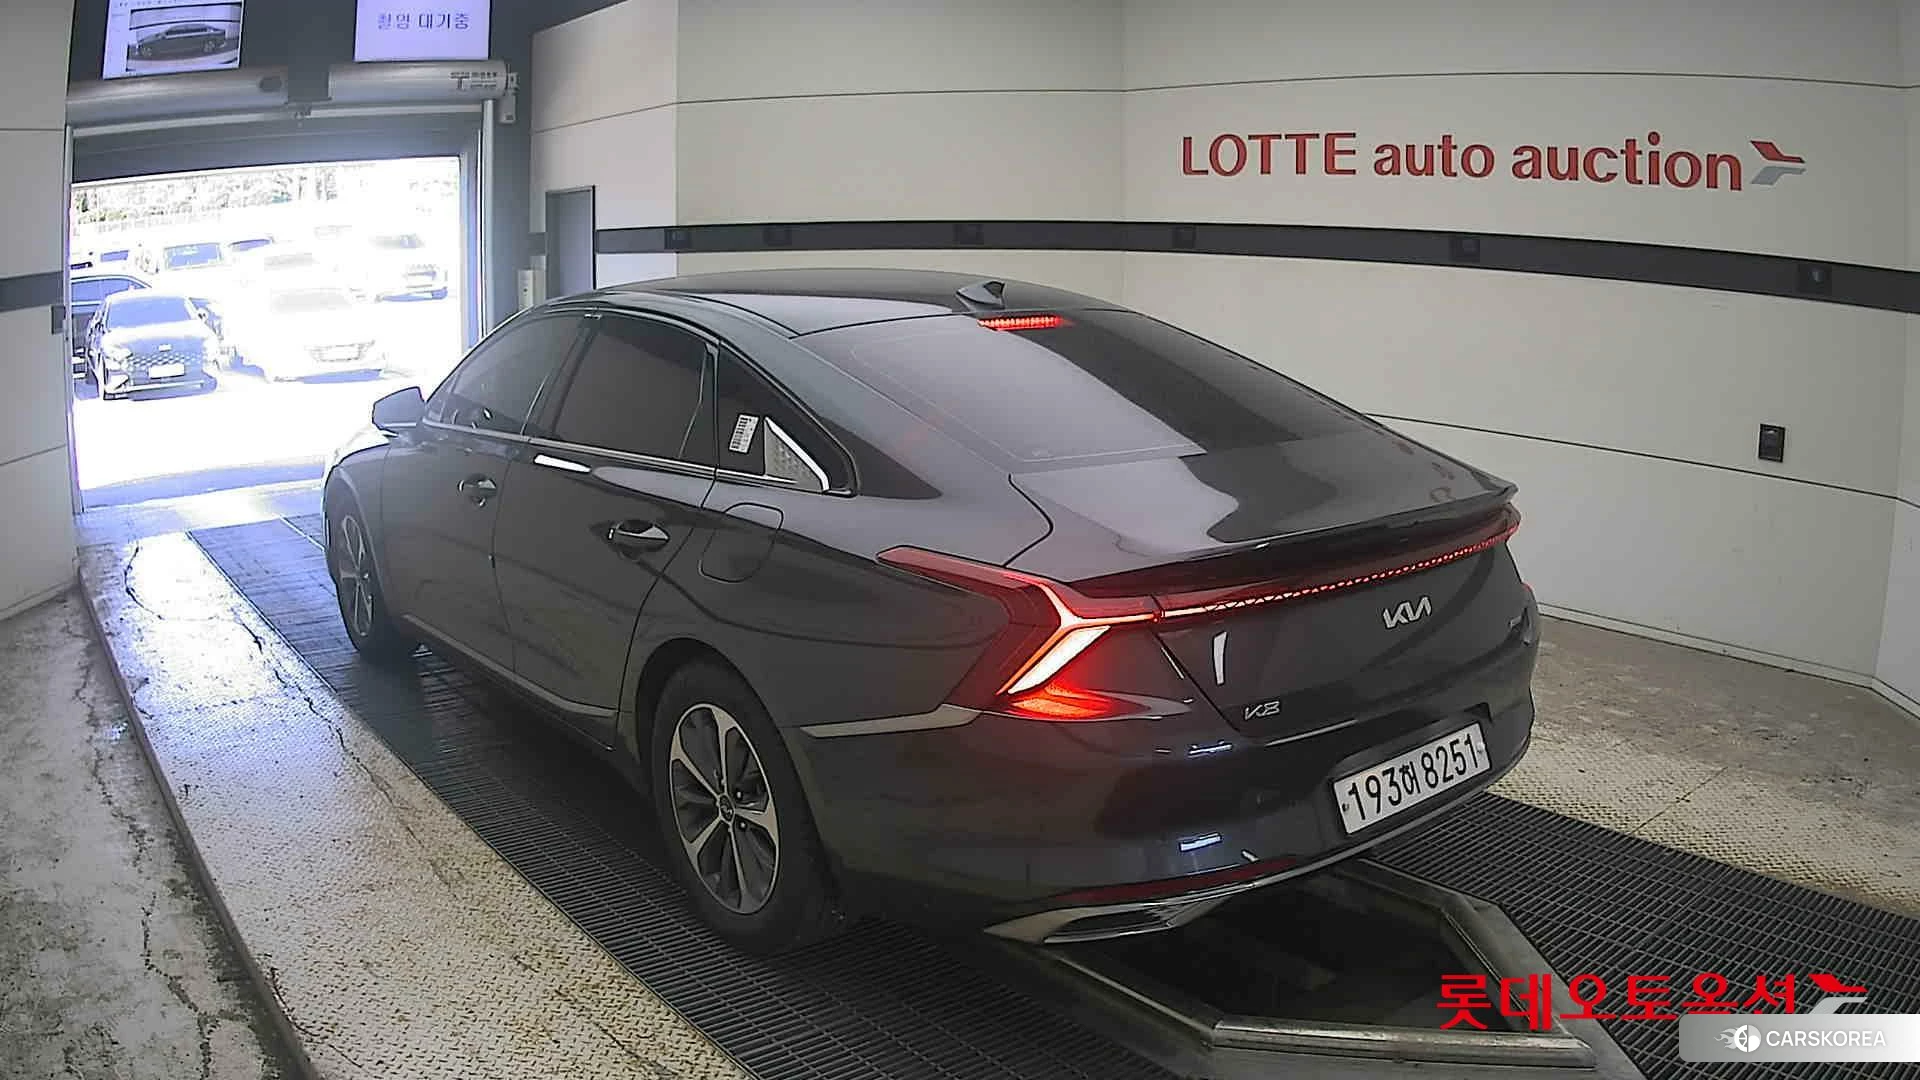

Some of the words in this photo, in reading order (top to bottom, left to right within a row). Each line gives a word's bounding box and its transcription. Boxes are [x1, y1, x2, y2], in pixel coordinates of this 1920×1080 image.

[418, 12, 470, 30] 대기중
[1182, 132, 1356, 177] LOTTE
[1373, 134, 1495, 178] auto
[1511, 131, 1742, 191] auction
[1244, 700, 1281, 721] K8
